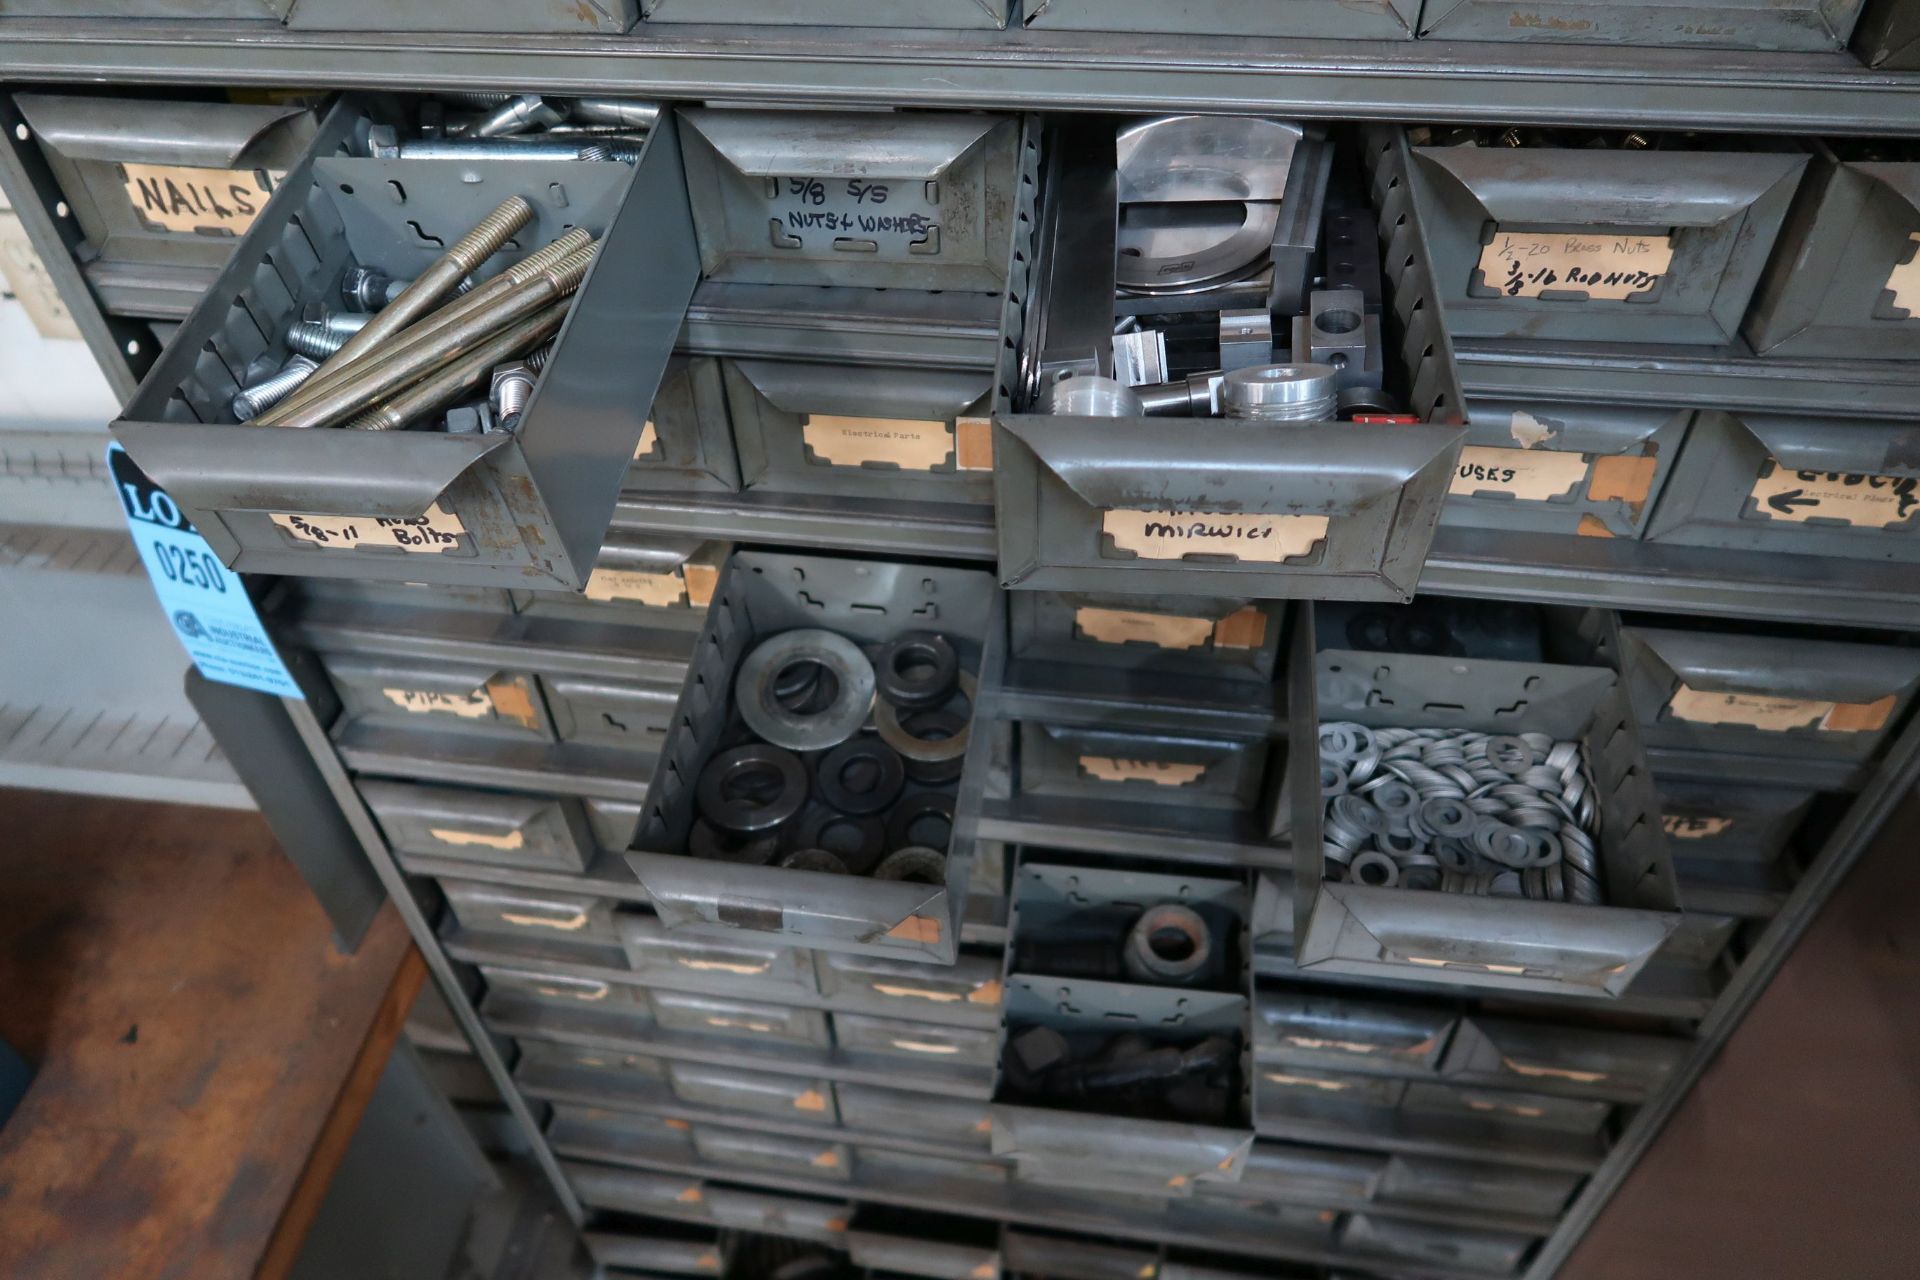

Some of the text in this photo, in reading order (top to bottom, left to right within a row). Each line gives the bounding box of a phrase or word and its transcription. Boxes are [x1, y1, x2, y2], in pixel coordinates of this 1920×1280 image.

[137, 177, 255, 219] NAILS
[1613, 238, 1650, 254] Nuts
[1454, 464, 1516, 482] USES
[124, 483, 197, 531] LO
[154, 541, 226, 594] 0250
